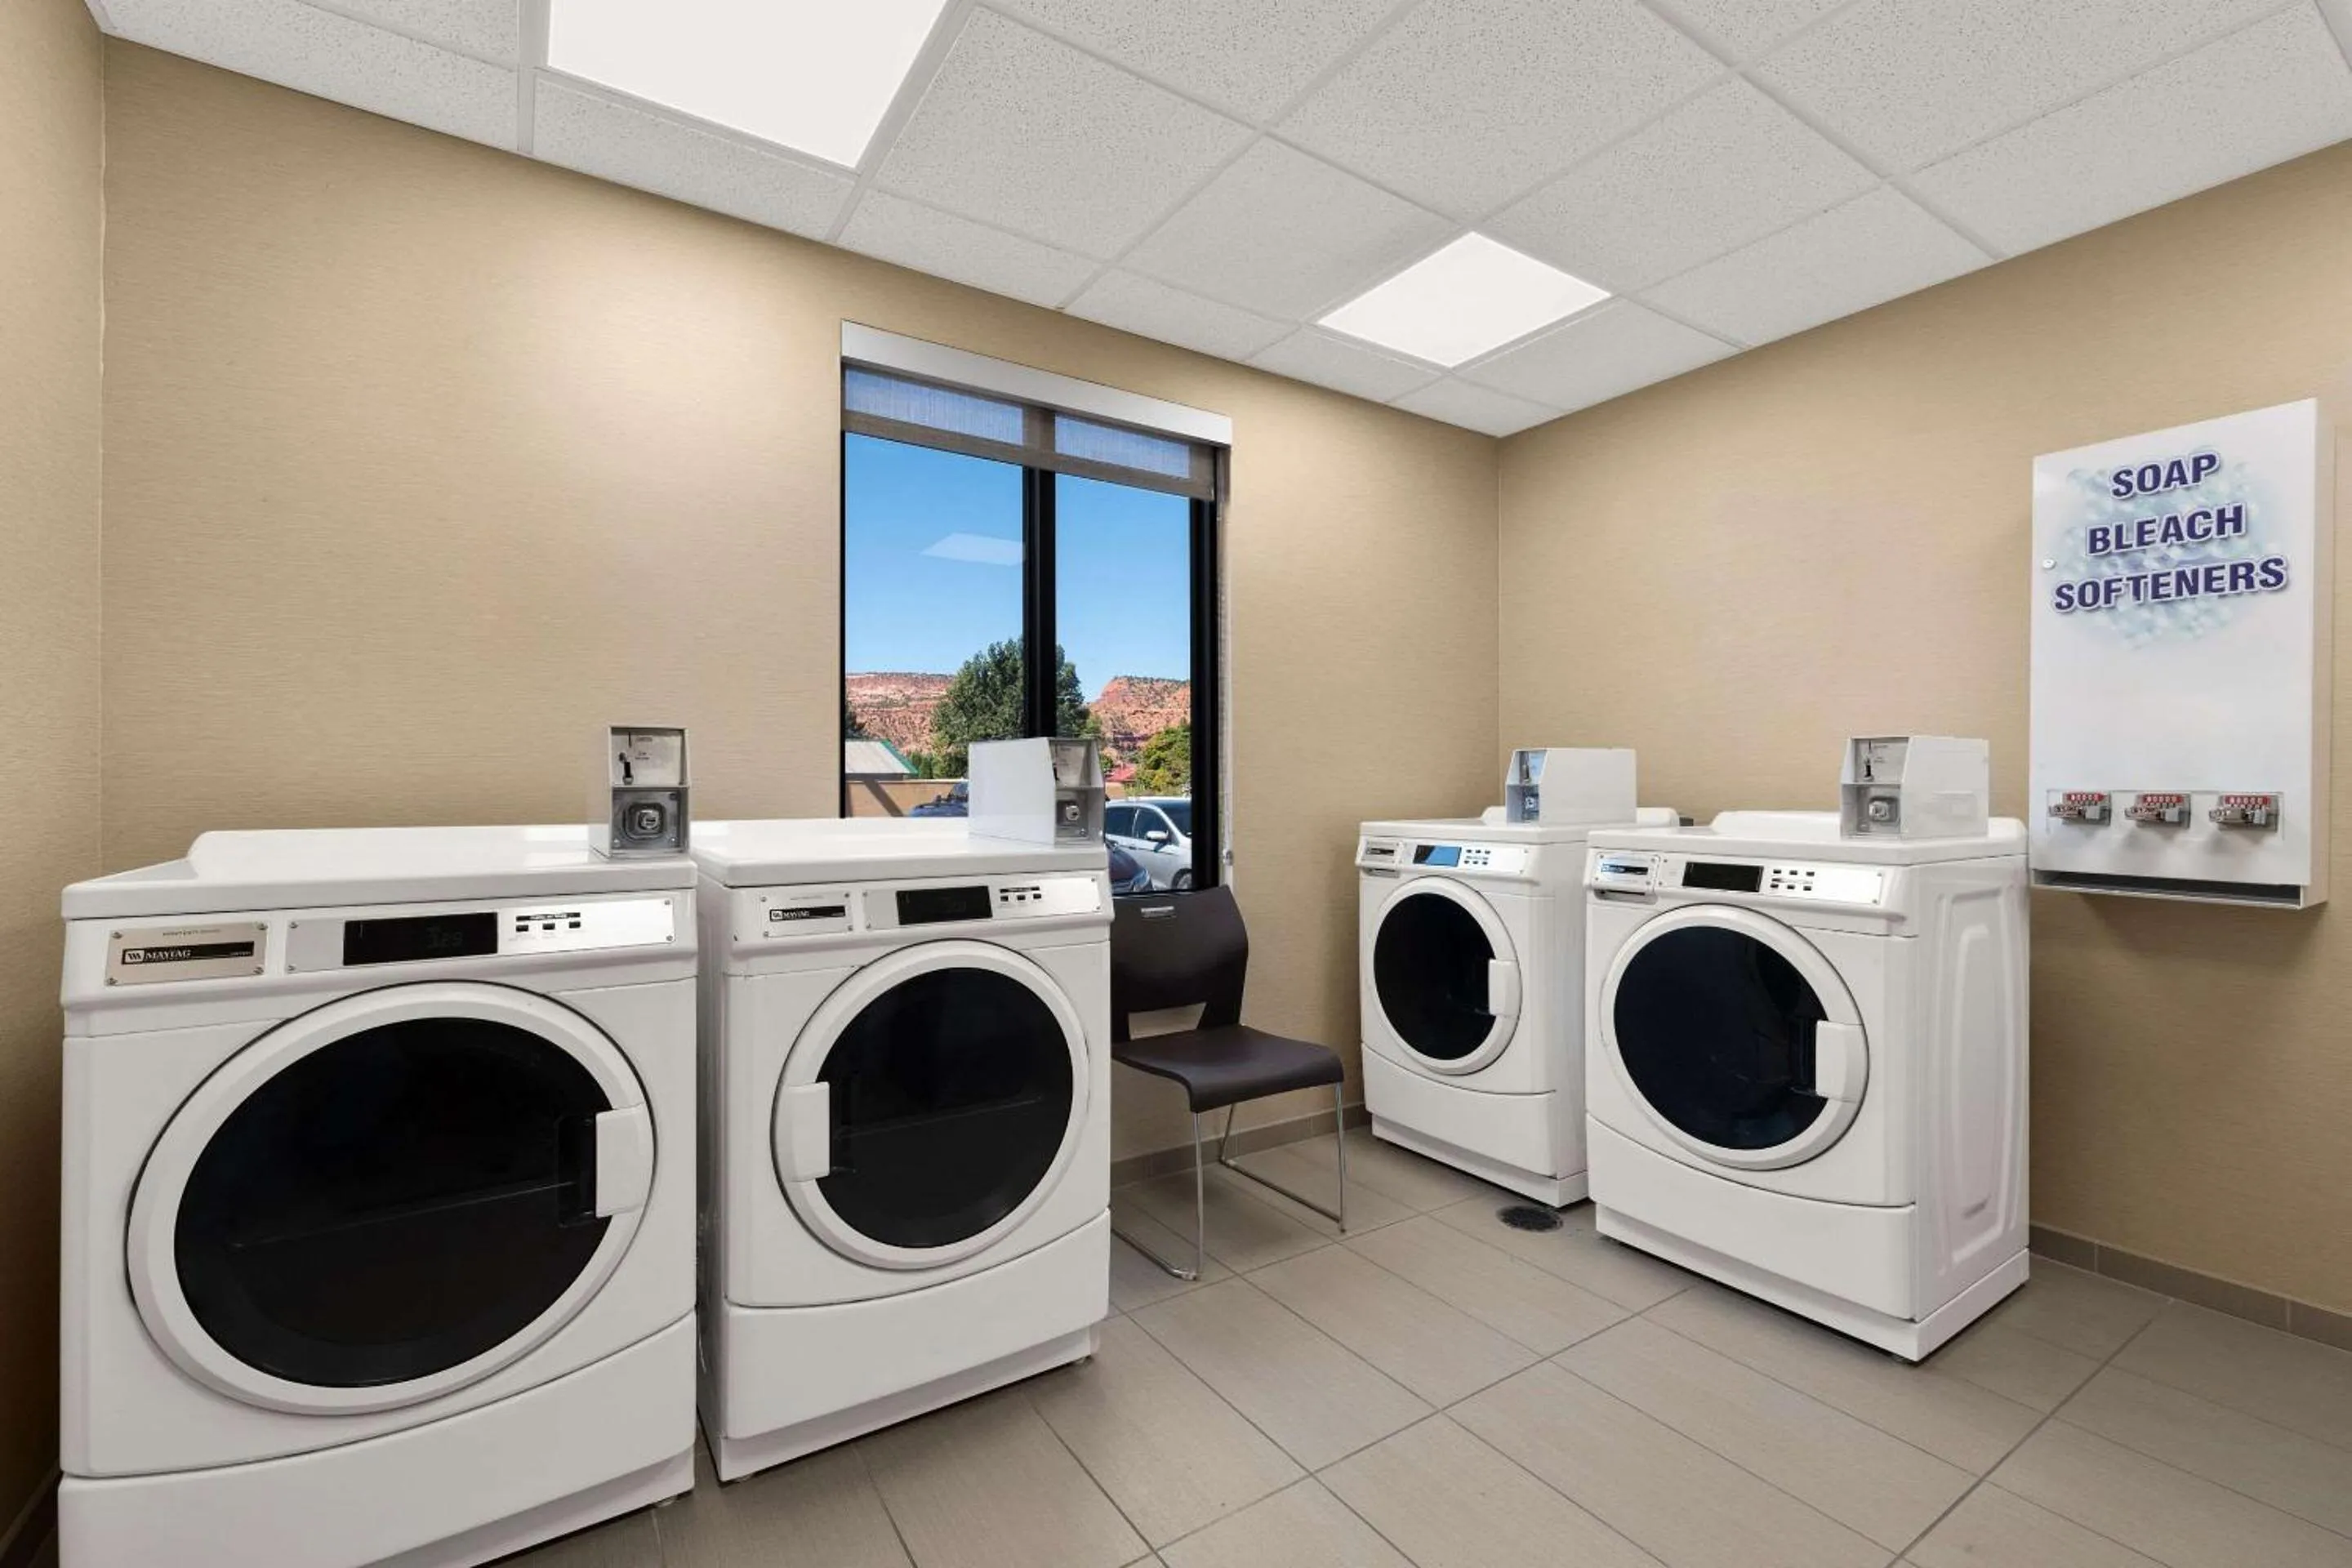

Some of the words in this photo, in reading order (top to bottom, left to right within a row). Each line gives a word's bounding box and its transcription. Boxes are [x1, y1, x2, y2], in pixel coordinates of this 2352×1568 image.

[2110, 452, 2220, 499] SOAP
[2087, 503, 2244, 556] BLEACH
[2053, 556, 2287, 612] SOFTENERS
[145, 949, 192, 962] MAYTAG
